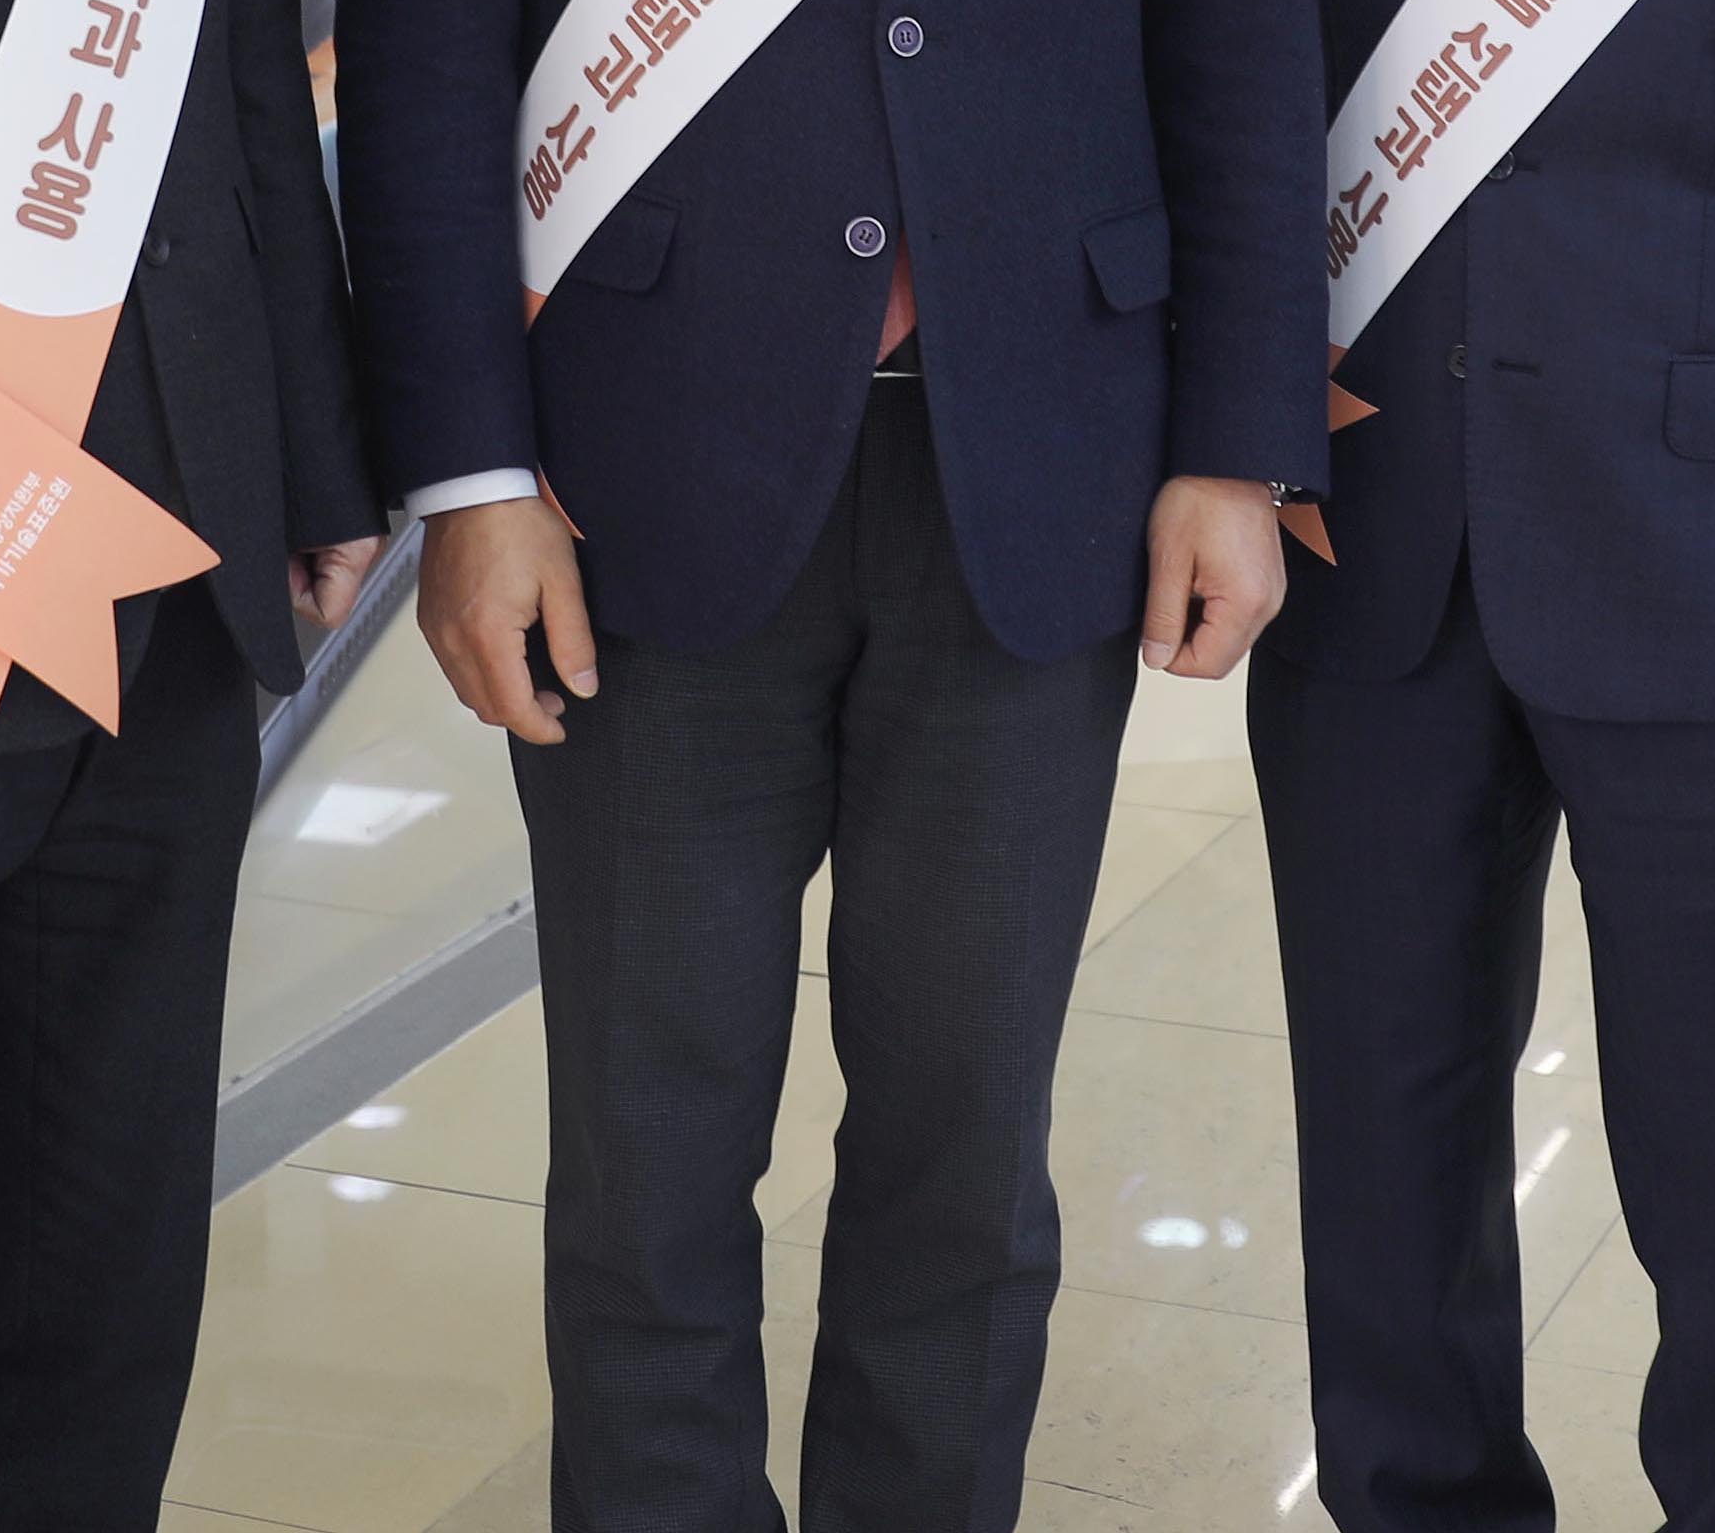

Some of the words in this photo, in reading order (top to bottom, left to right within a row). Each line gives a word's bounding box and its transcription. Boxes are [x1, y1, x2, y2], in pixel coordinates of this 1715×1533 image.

[15, 91, 115, 242] 사용
[522, 102, 597, 222] 사용
[1374, 21, 1515, 182] 선택과
[1327, 170, 1389, 280] 사용
